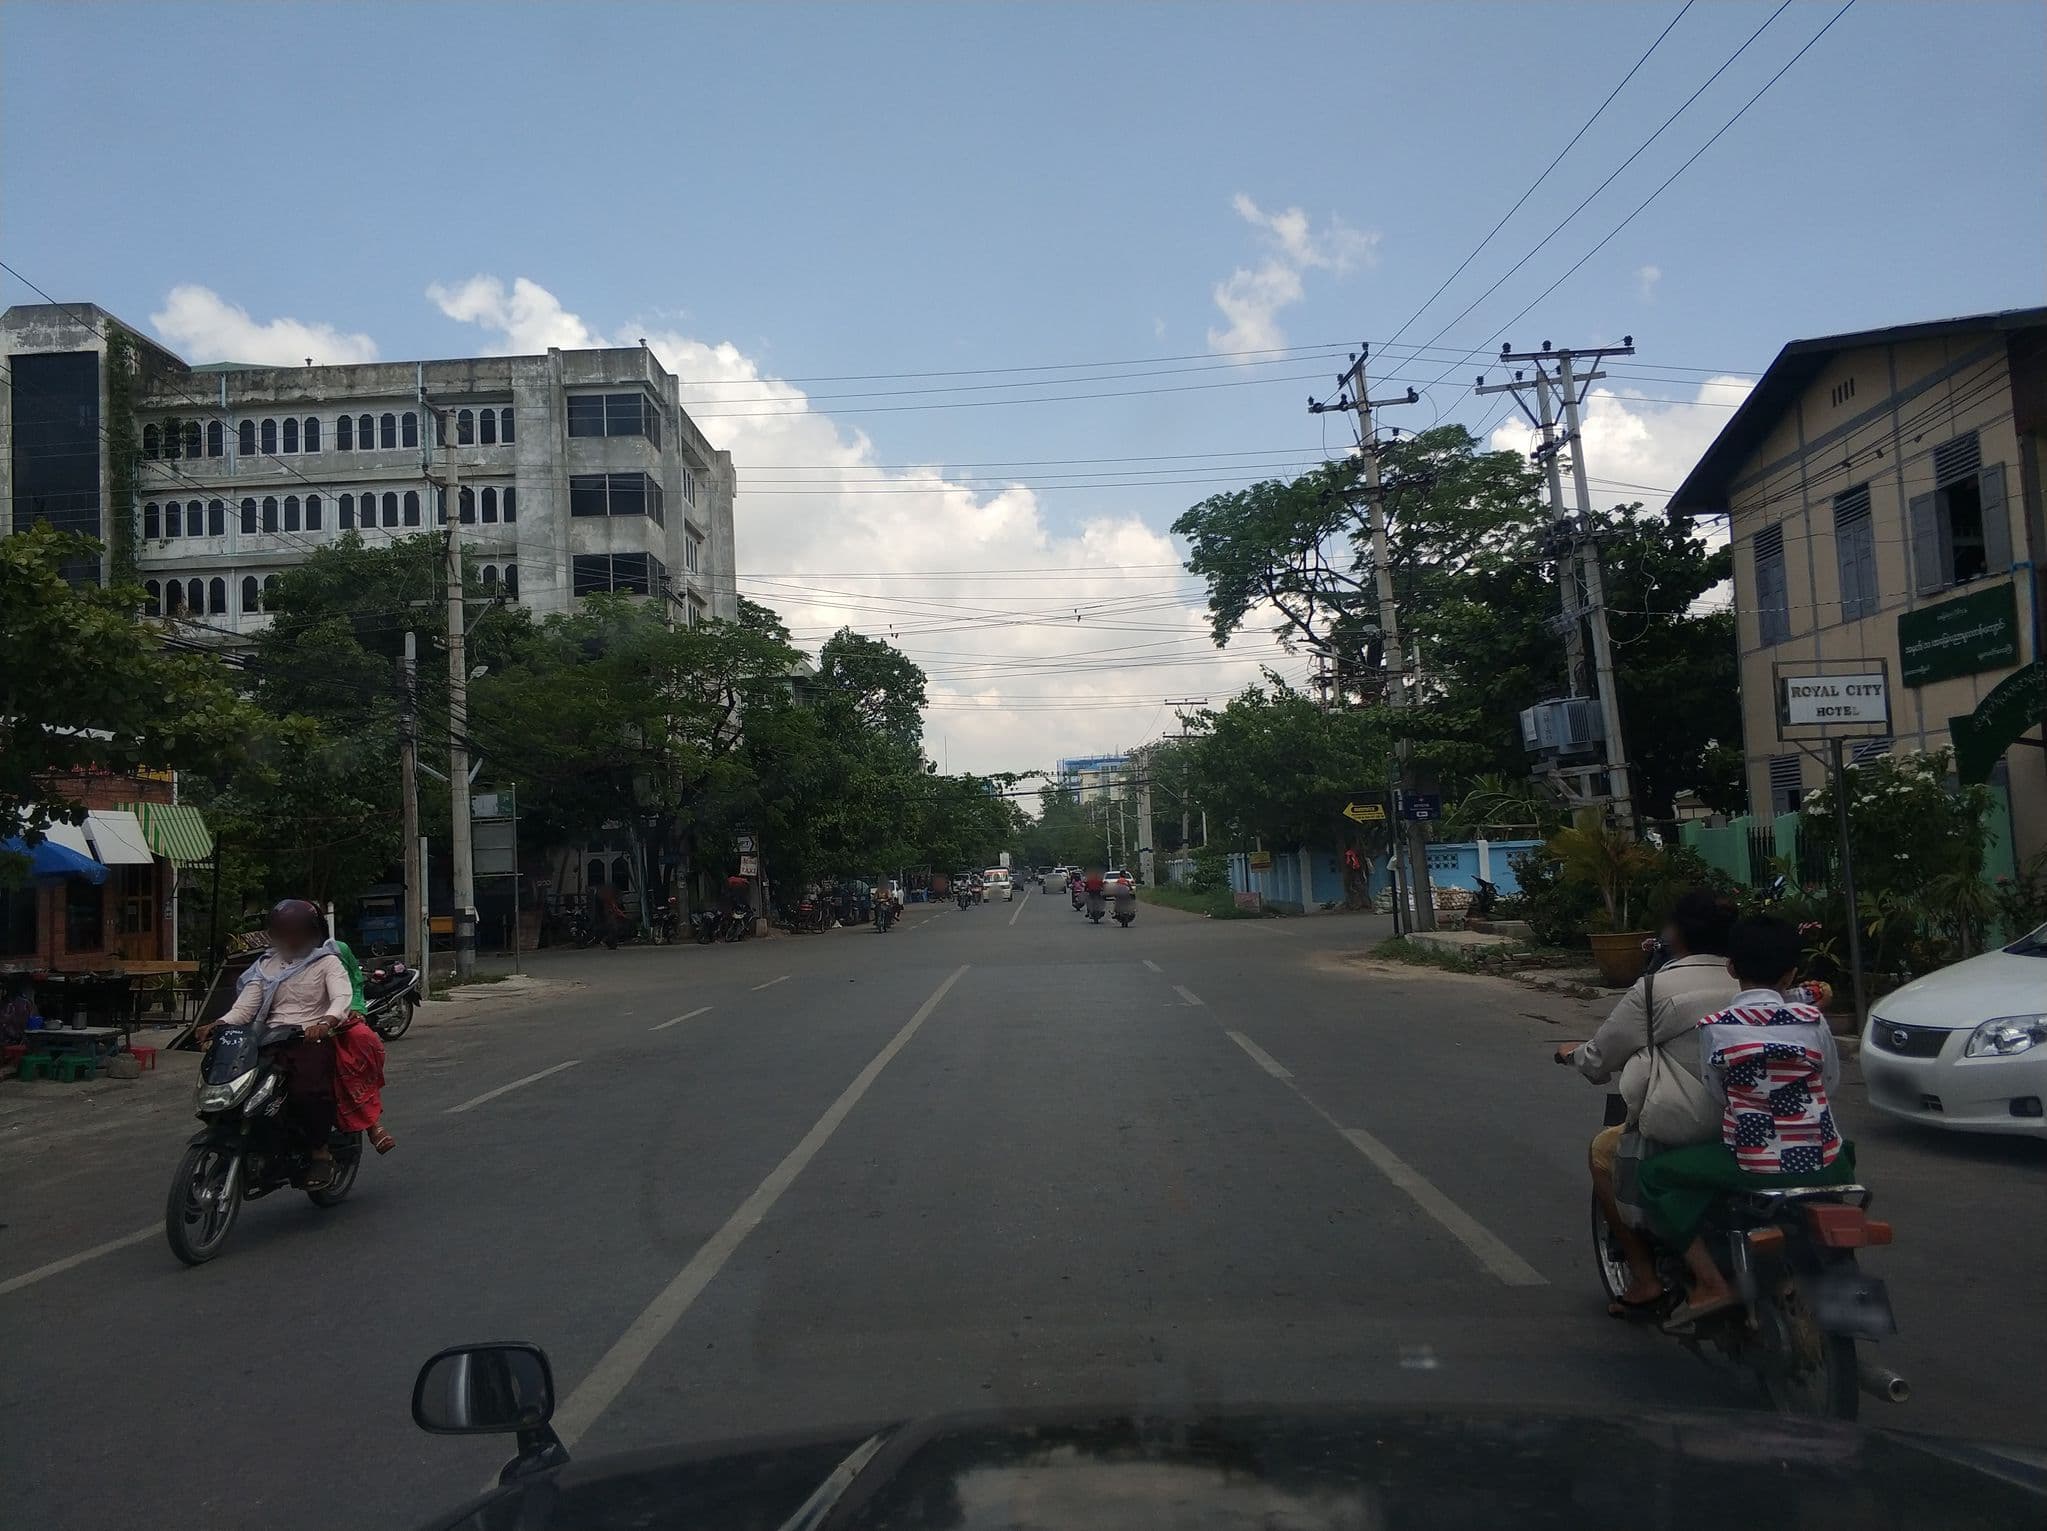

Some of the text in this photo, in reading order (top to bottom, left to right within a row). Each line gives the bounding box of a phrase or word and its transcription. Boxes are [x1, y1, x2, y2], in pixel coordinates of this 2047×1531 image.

[1791, 685, 1881, 698] ROYAL CITY
[1816, 706, 1859, 716] HOTEL
